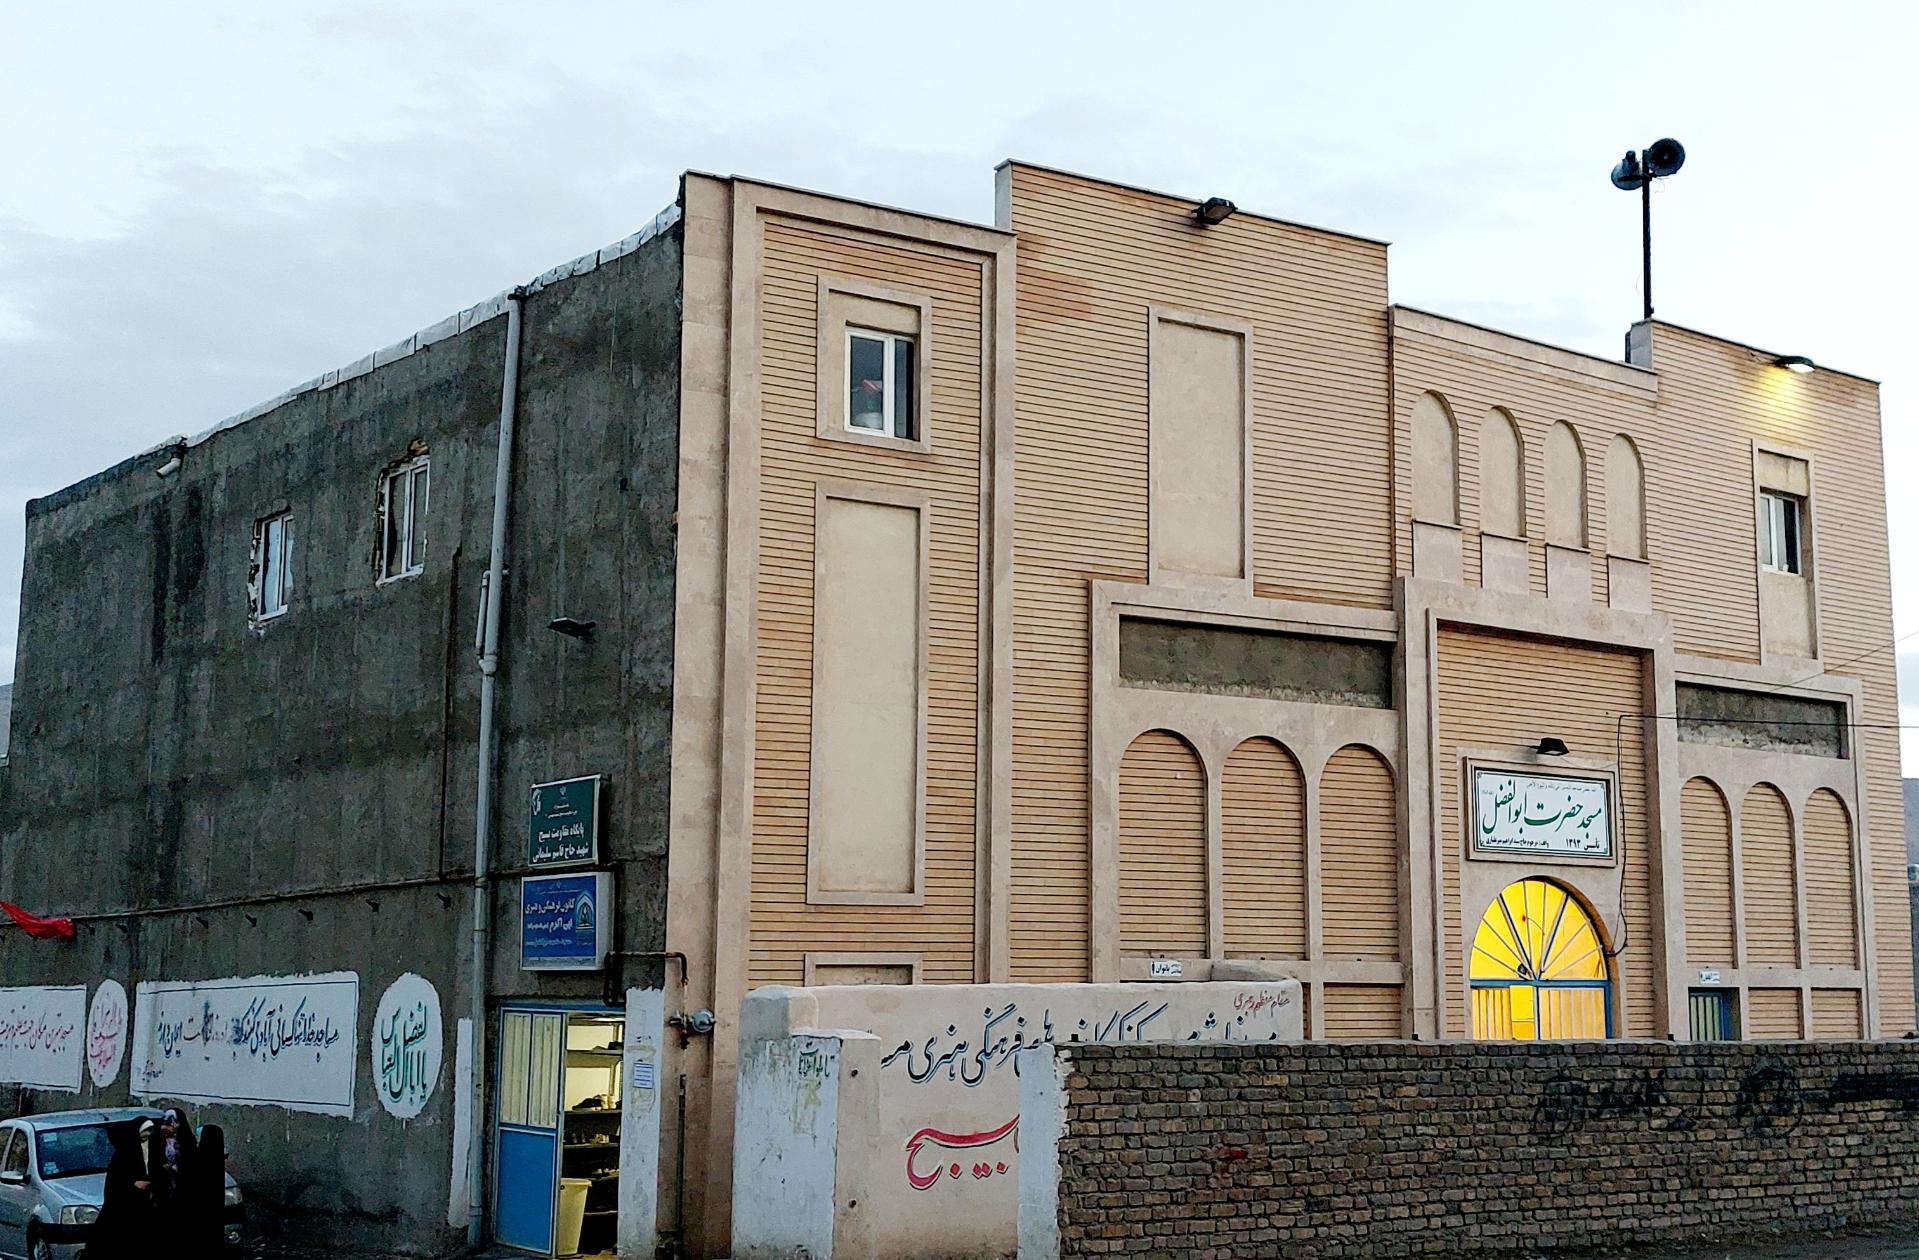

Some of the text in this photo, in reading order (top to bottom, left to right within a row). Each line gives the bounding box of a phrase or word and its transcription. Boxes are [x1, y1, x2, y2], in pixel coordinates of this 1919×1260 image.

[1482, 779, 1601, 839] مسجد حضرت ابوالفضل
[908, 1024, 969, 1083] هنری
[961, 1003, 1026, 1087] فرهنگی
